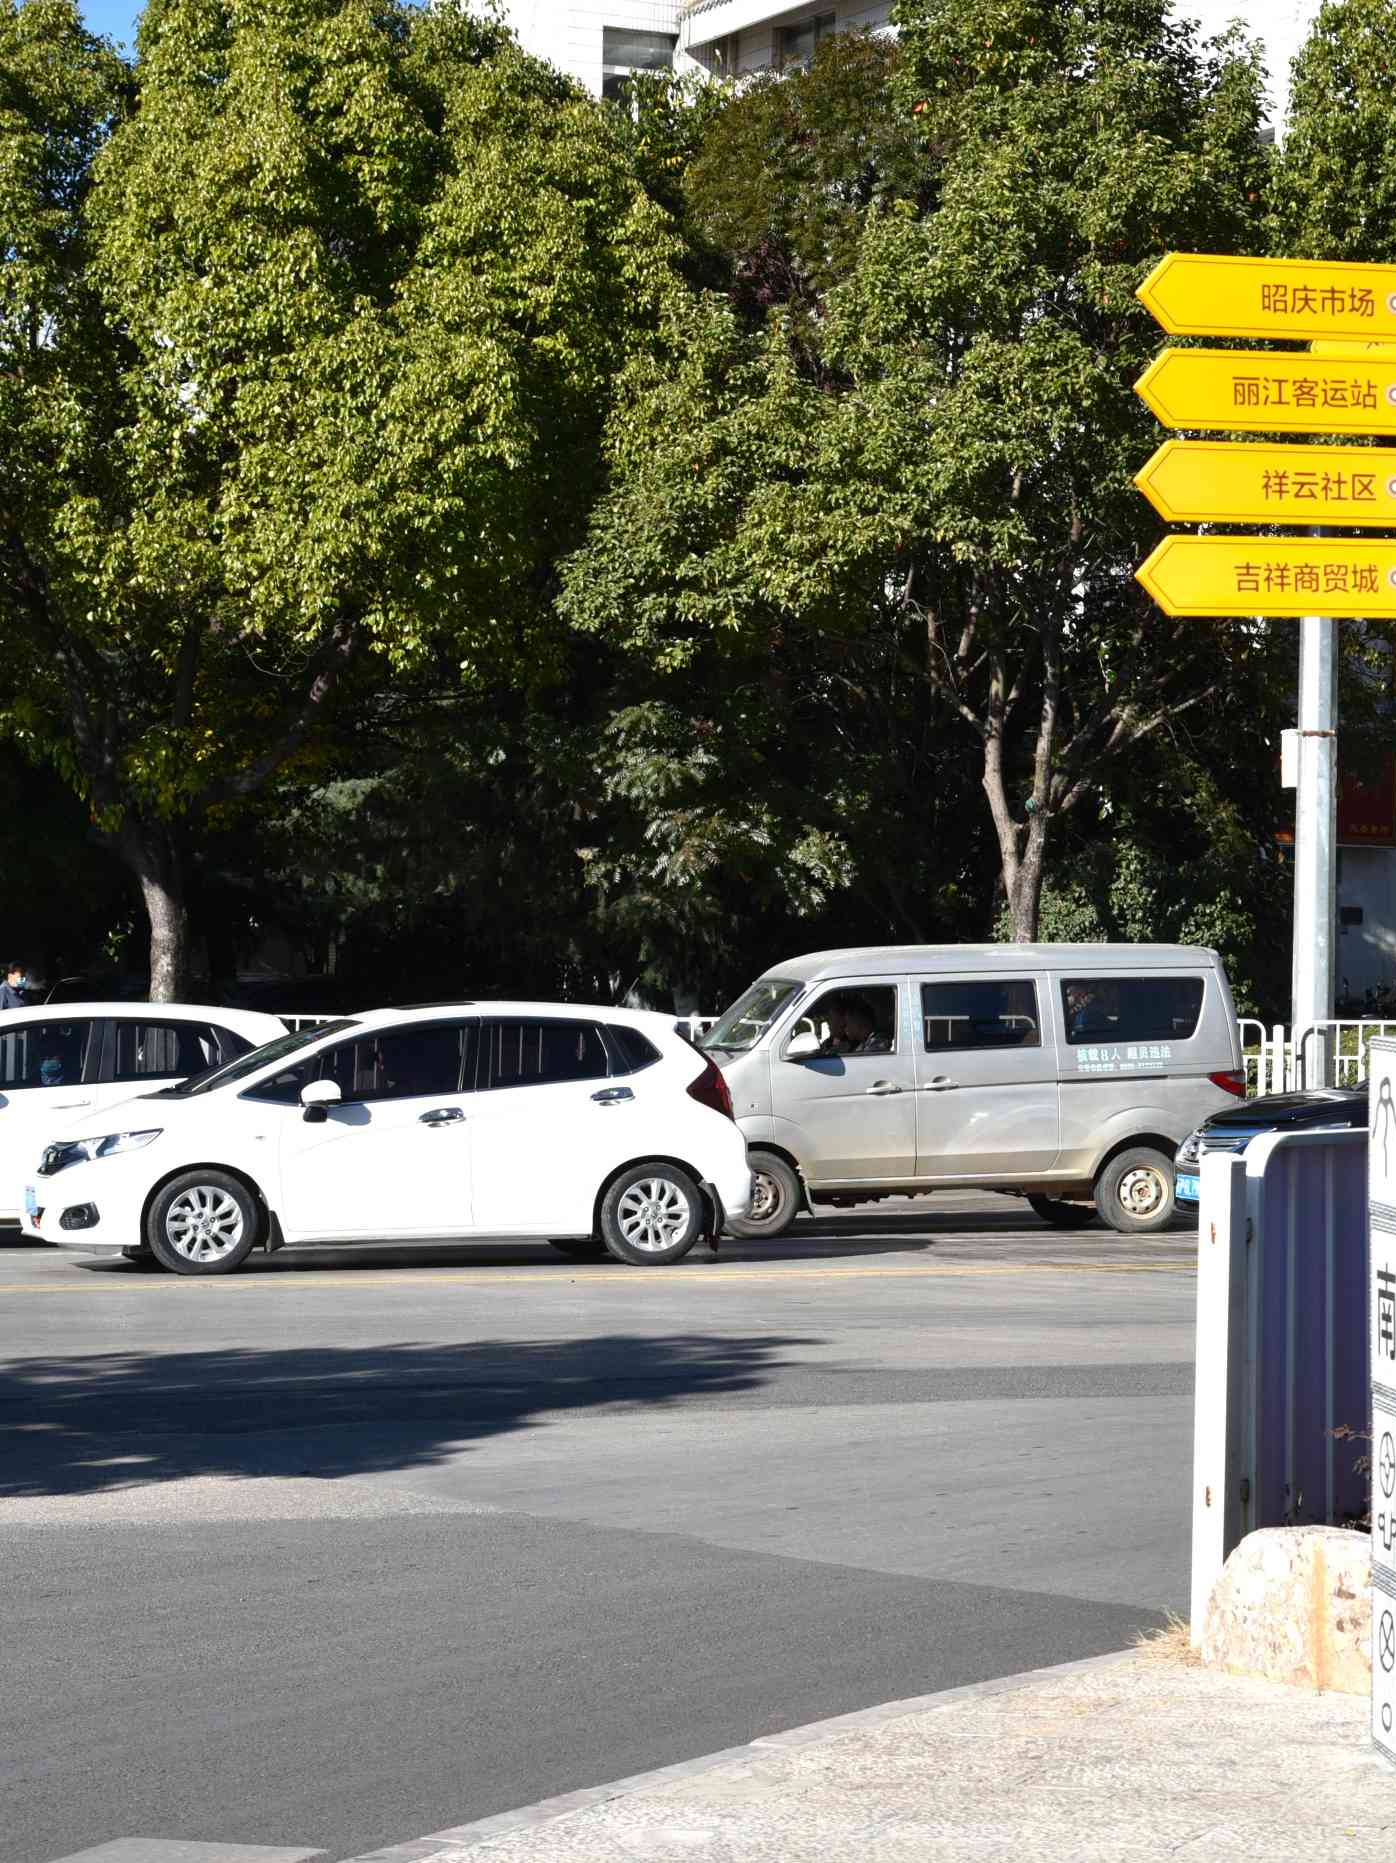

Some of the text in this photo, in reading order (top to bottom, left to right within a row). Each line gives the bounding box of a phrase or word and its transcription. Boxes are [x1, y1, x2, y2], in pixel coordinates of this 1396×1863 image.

[1261, 284, 1375, 317] 昭庆市场
[1232, 376, 1378, 409] 丽江客运站
[1262, 469, 1377, 501] 祥云社区
[1233, 563, 1379, 594] 吉祥商贸城
[1377, 1262, 1396, 1360] 南
